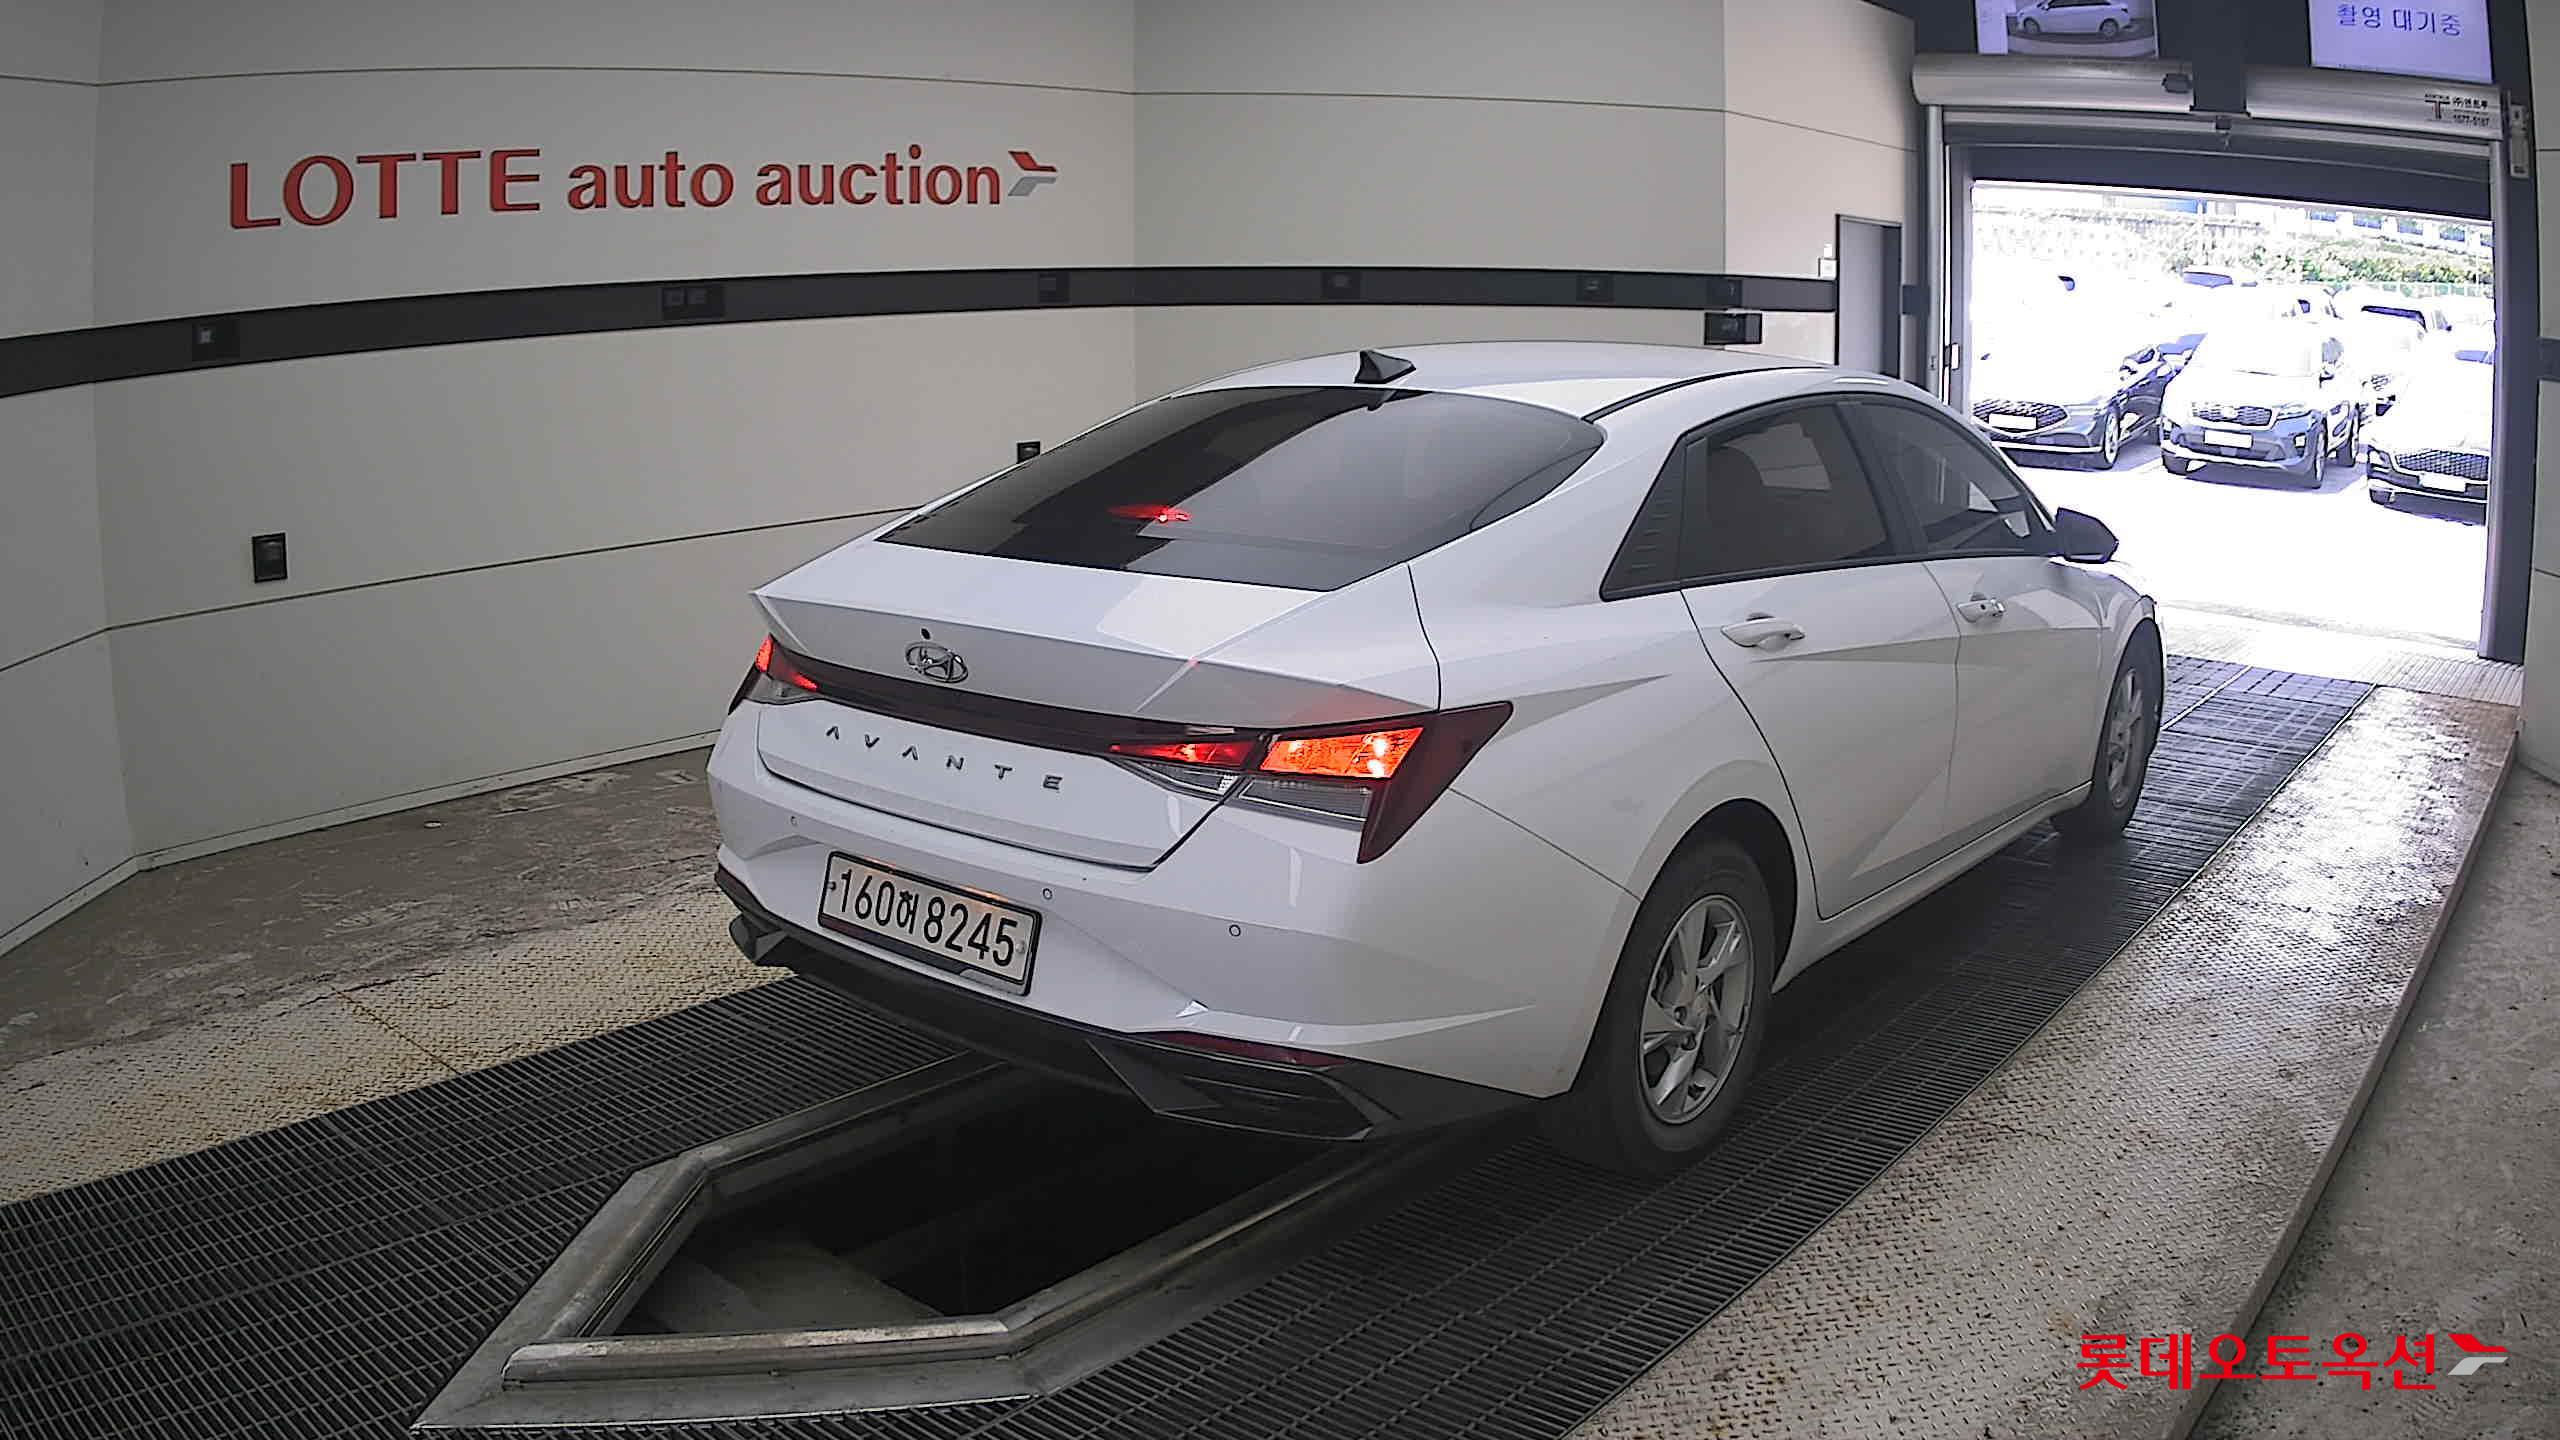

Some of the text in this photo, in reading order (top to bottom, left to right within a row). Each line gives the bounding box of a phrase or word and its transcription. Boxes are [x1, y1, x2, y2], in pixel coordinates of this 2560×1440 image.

[2337, 4, 2461, 36] 촬영 대기중
[230, 146, 1002, 228] LOTTE auto auction
[826, 725, 1064, 791] AVANTE
[840, 868, 1019, 967] 160허8245
